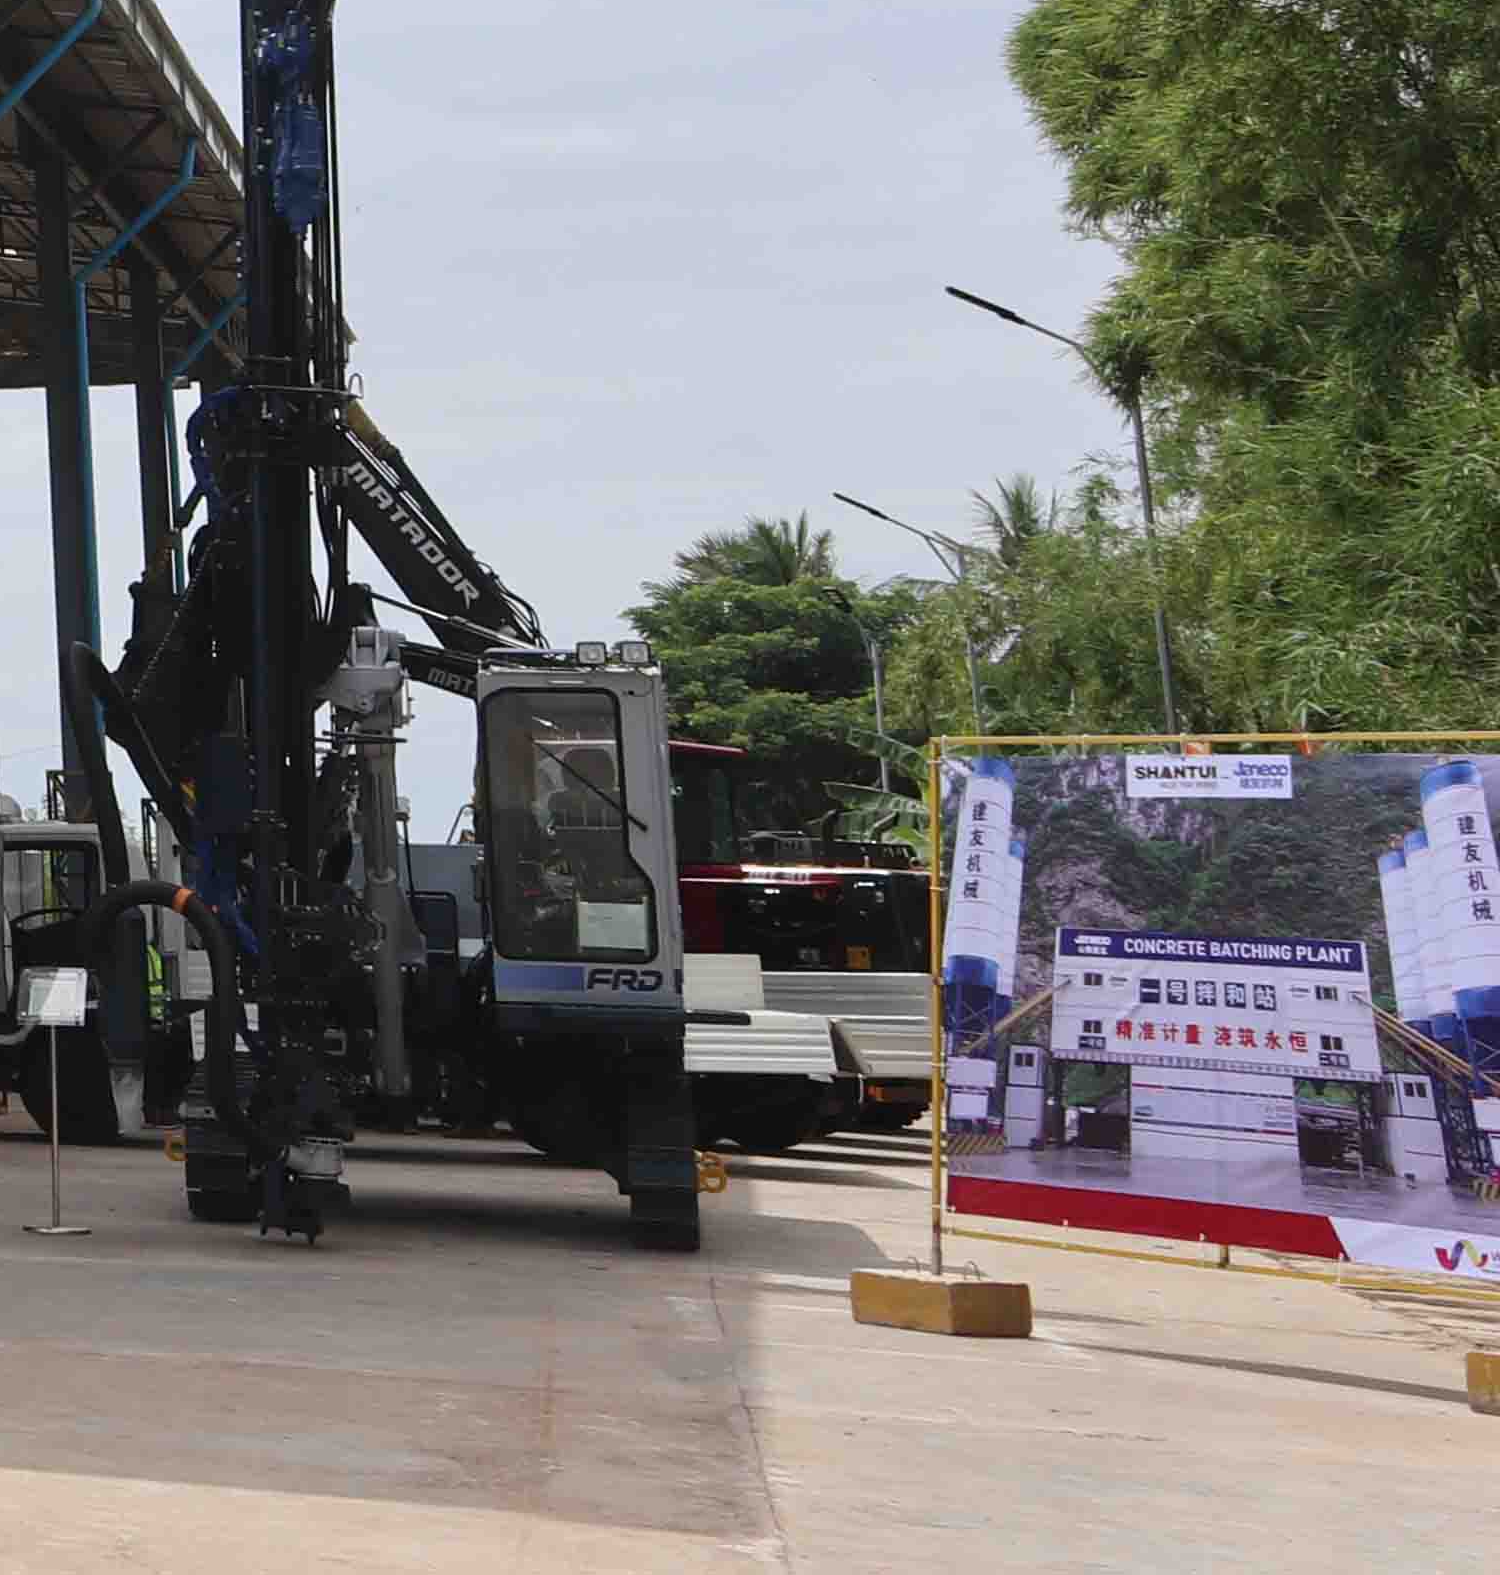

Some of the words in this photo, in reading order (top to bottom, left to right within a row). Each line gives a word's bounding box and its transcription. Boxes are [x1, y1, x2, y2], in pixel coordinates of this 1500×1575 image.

[348, 461, 480, 610] MATADOR
[1134, 765, 1218, 780] SHANTUI
[1457, 816, 1494, 922] 建友机械
[1123, 937, 1206, 957] CONCRETE
[1210, 941, 1293, 962] BATCHING
[1296, 945, 1352, 965] PLANT
[588, 968, 663, 992] FRD
